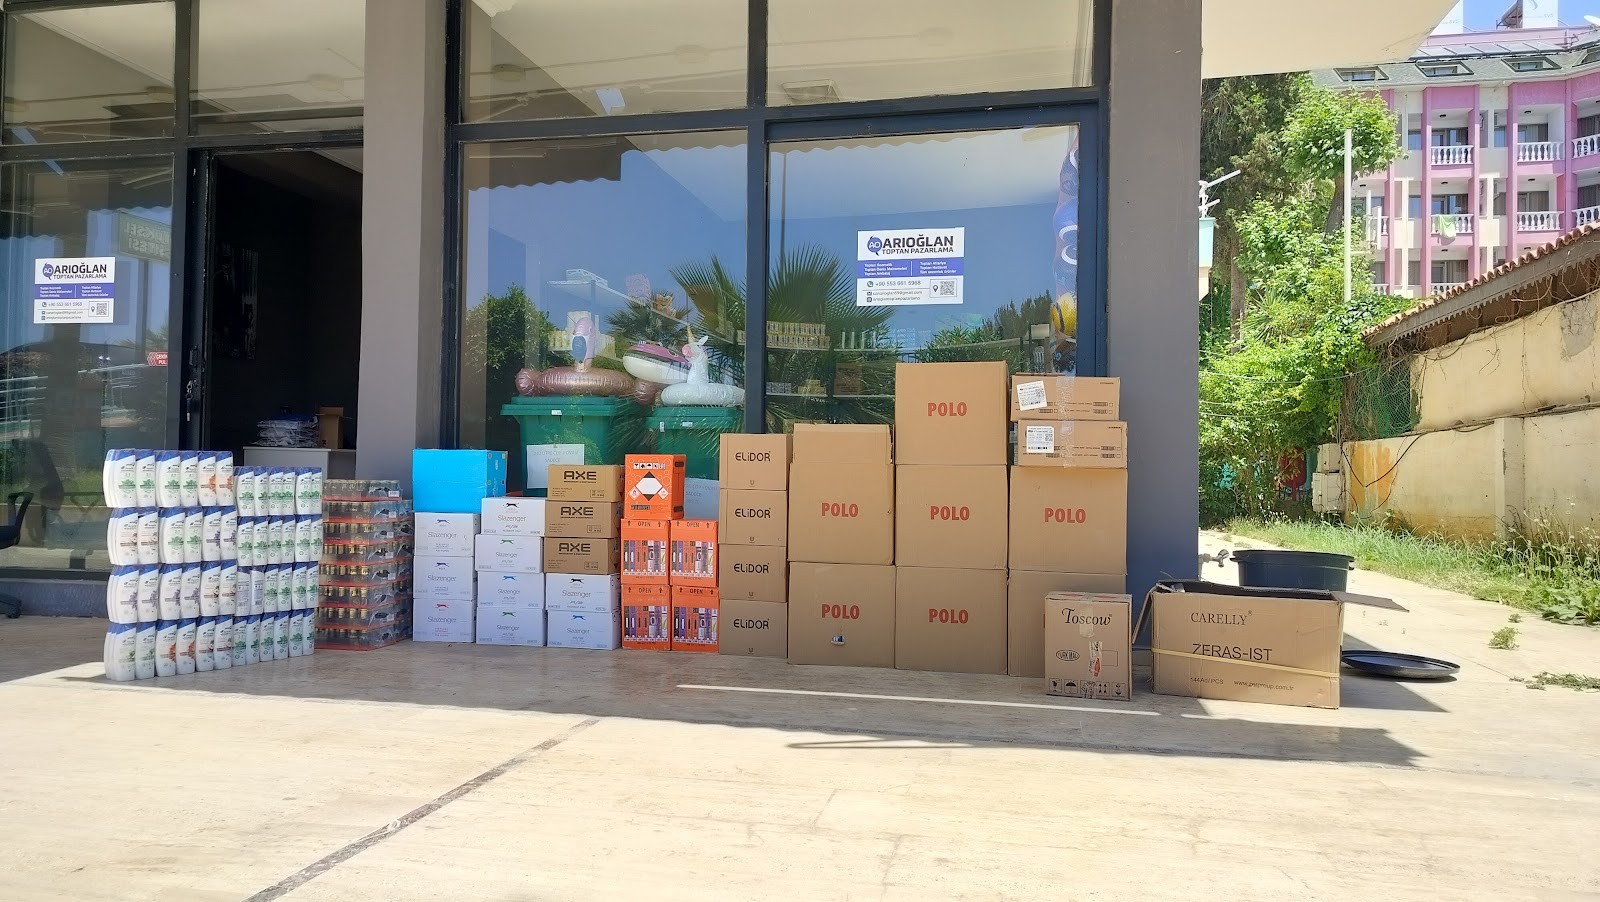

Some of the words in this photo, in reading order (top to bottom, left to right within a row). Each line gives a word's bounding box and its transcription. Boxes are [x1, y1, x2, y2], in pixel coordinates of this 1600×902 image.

[883, 234, 954, 249] ARIOĞLAN
[54, 262, 107, 274] ARIOĞLAN
[928, 402, 968, 416] POLO
[564, 471, 596, 480] AXE
[560, 507, 593, 515] AXE
[822, 502, 858, 518] POLO
[930, 506, 970, 520] POLO
[1044, 508, 1086, 524] POLO
[559, 543, 590, 552] AXE
[562, 590, 591, 598] Slazenger
[822, 604, 860, 620] POLO
[928, 608, 969, 624] POLO
[1062, 608, 1111, 626] Toscow
[1190, 612, 1248, 625] CARELLY
[1192, 643, 1272, 661] ZERAS-IST
